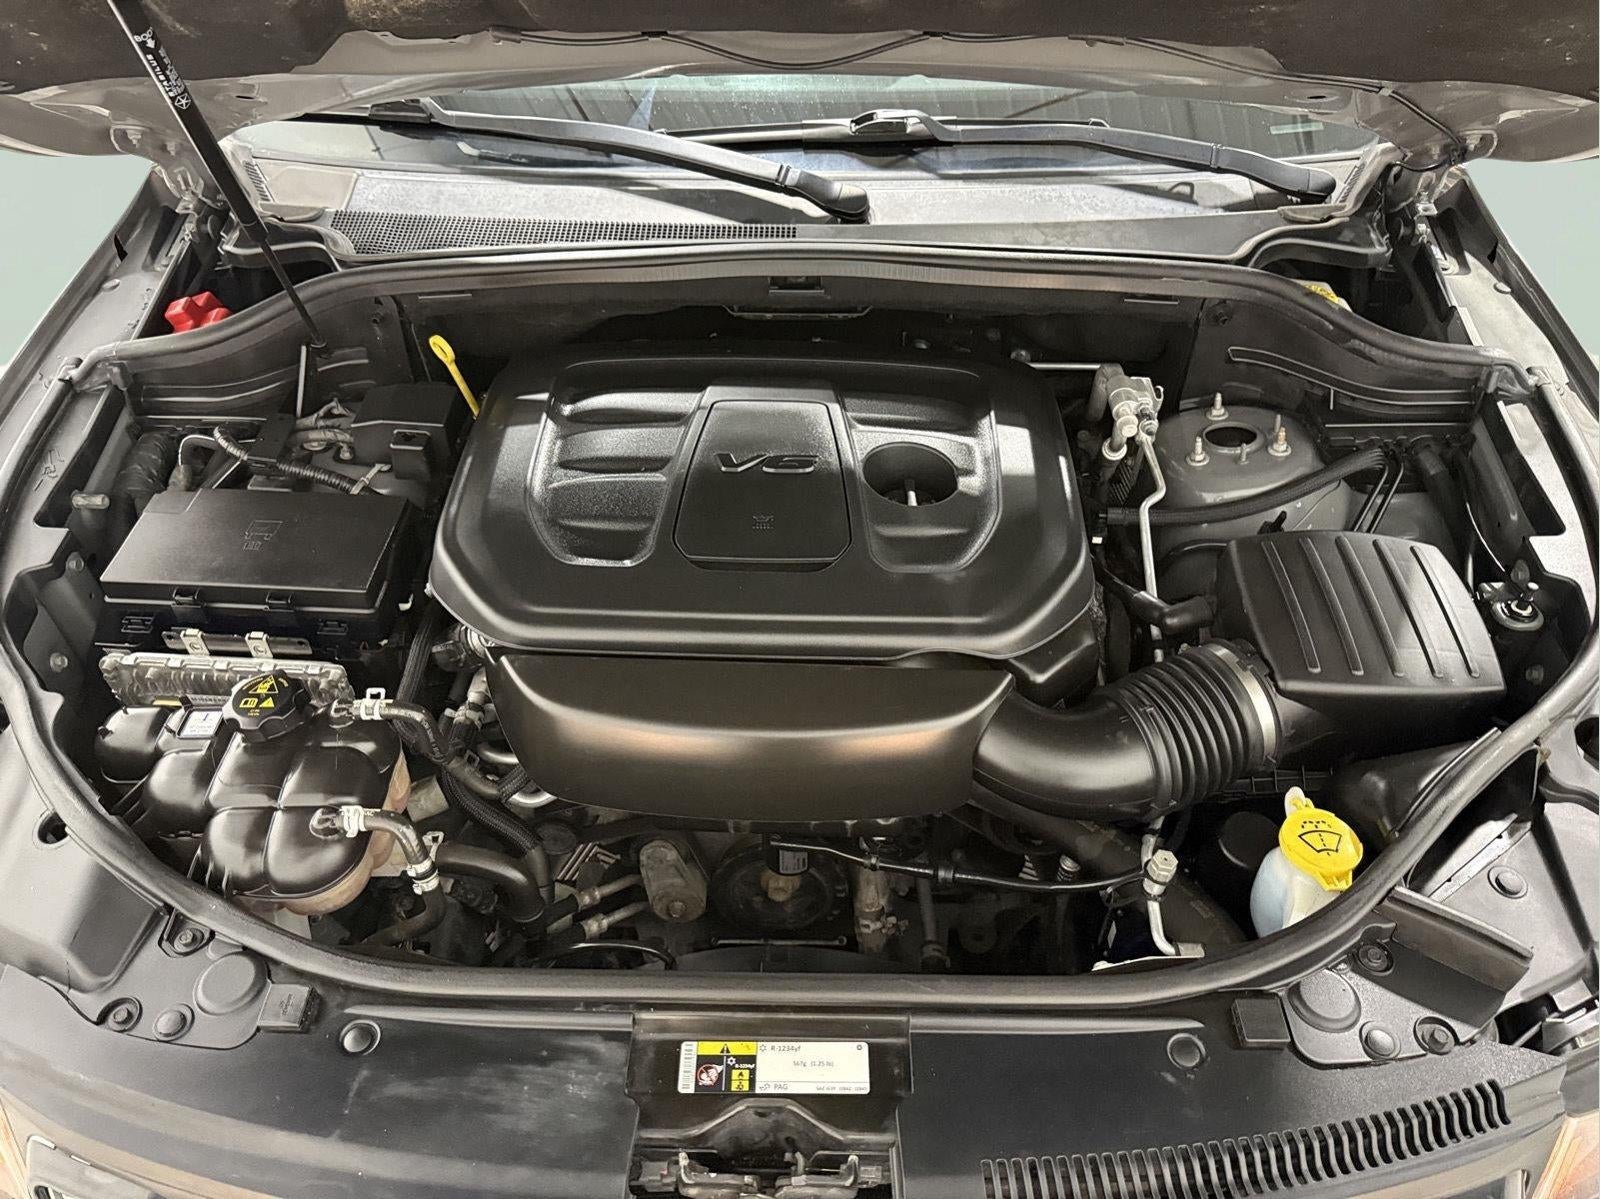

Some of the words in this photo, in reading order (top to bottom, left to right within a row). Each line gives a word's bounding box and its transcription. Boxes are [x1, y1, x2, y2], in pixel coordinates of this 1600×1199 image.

[146, 54, 176, 97] STABILUS
[714, 452, 820, 474] V6
[770, 1045, 801, 1053] R-1234yf
[774, 1083, 789, 1091] PAG
